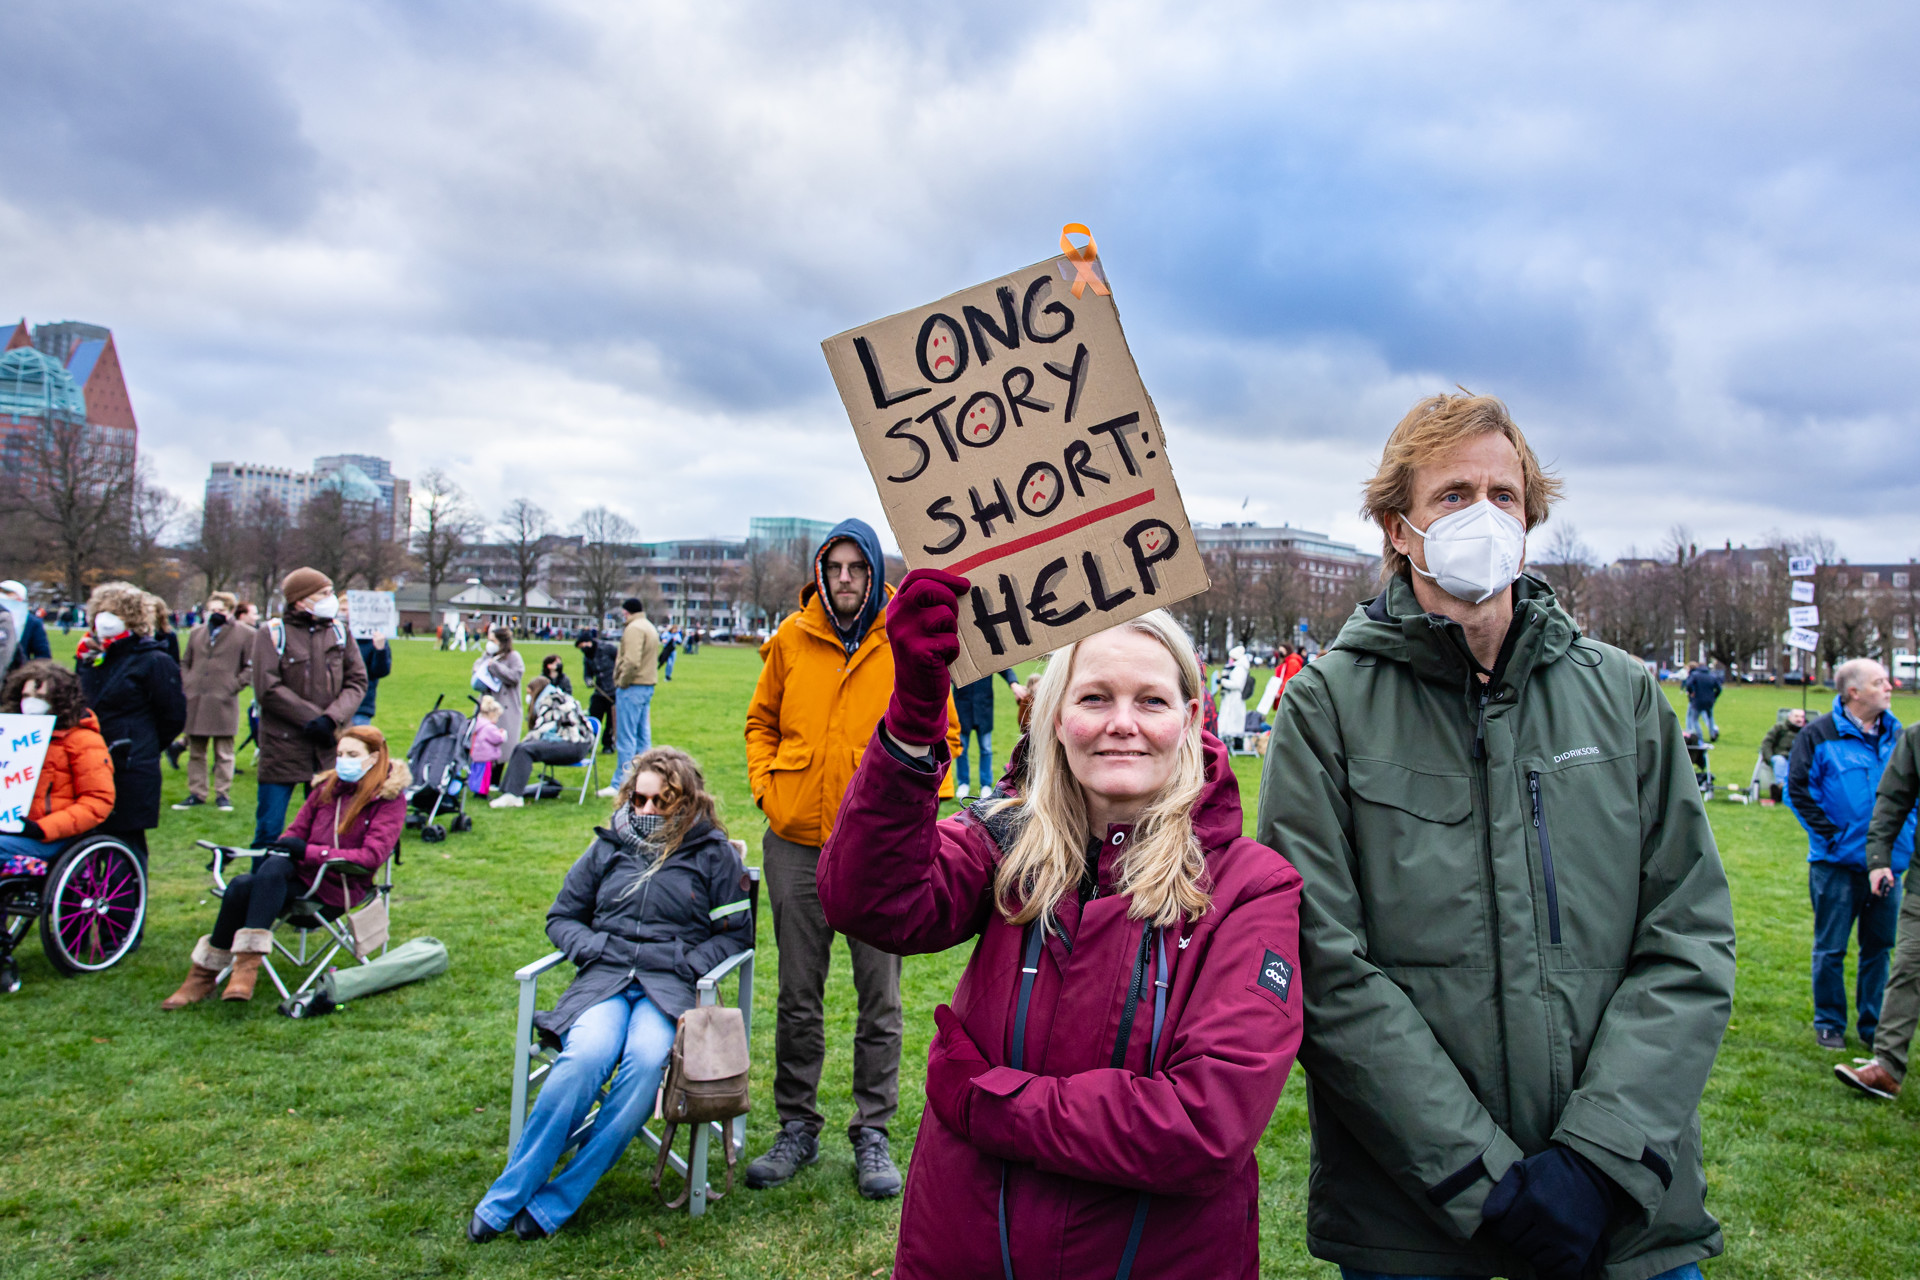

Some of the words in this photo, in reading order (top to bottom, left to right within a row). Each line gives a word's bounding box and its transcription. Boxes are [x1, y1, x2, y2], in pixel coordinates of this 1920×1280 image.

[852, 275, 1075, 409] LONG
[885, 343, 1091, 483] STORY
[923, 411, 1157, 555] SHORT:
[971, 518, 1180, 655] HELP
[4, 766, 34, 789] ME
[12, 729, 42, 752] ME
[1553, 746, 1600, 763] DIDRIKSONS
